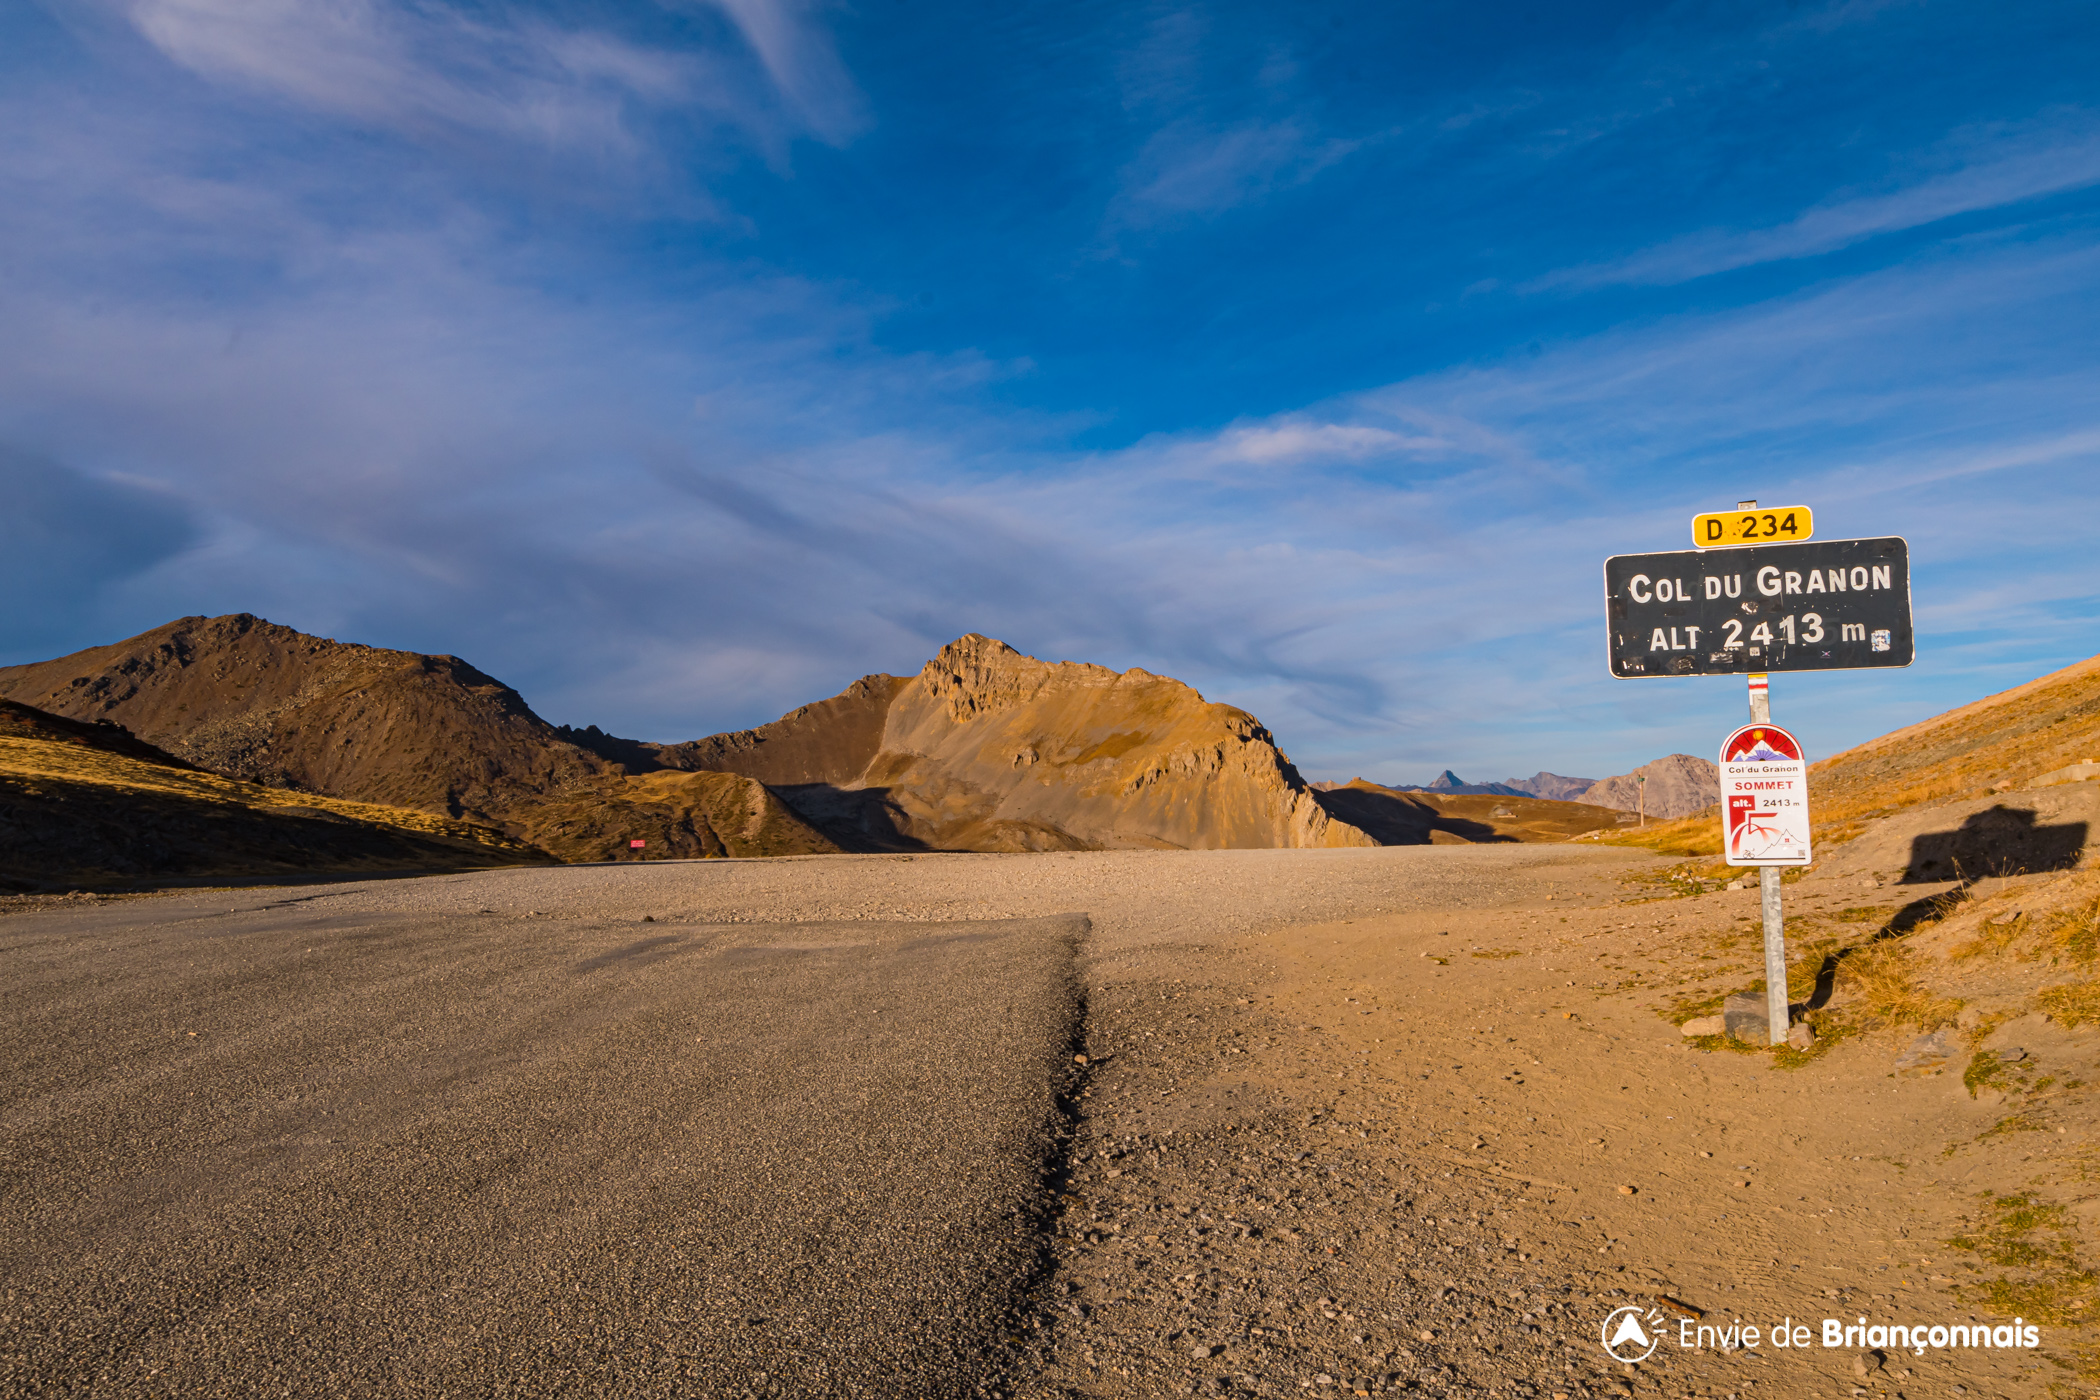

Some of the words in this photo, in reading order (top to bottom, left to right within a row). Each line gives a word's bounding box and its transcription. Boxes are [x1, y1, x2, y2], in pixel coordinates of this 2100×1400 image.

[1706, 519, 1723, 541] D
[1741, 512, 1798, 539] 234
[1629, 573, 1692, 604] COL
[1705, 574, 1742, 600] DU
[1756, 564, 1892, 597] GRANON
[1649, 625, 1700, 652] ALT
[1721, 612, 1825, 648] 2413
[1841, 622, 1866, 642] m
[1728, 766, 1744, 774] Col
[1735, 781, 1793, 790] SOMMET
[1732, 799, 1752, 808] alt.
[1763, 799, 1791, 807] 2413
